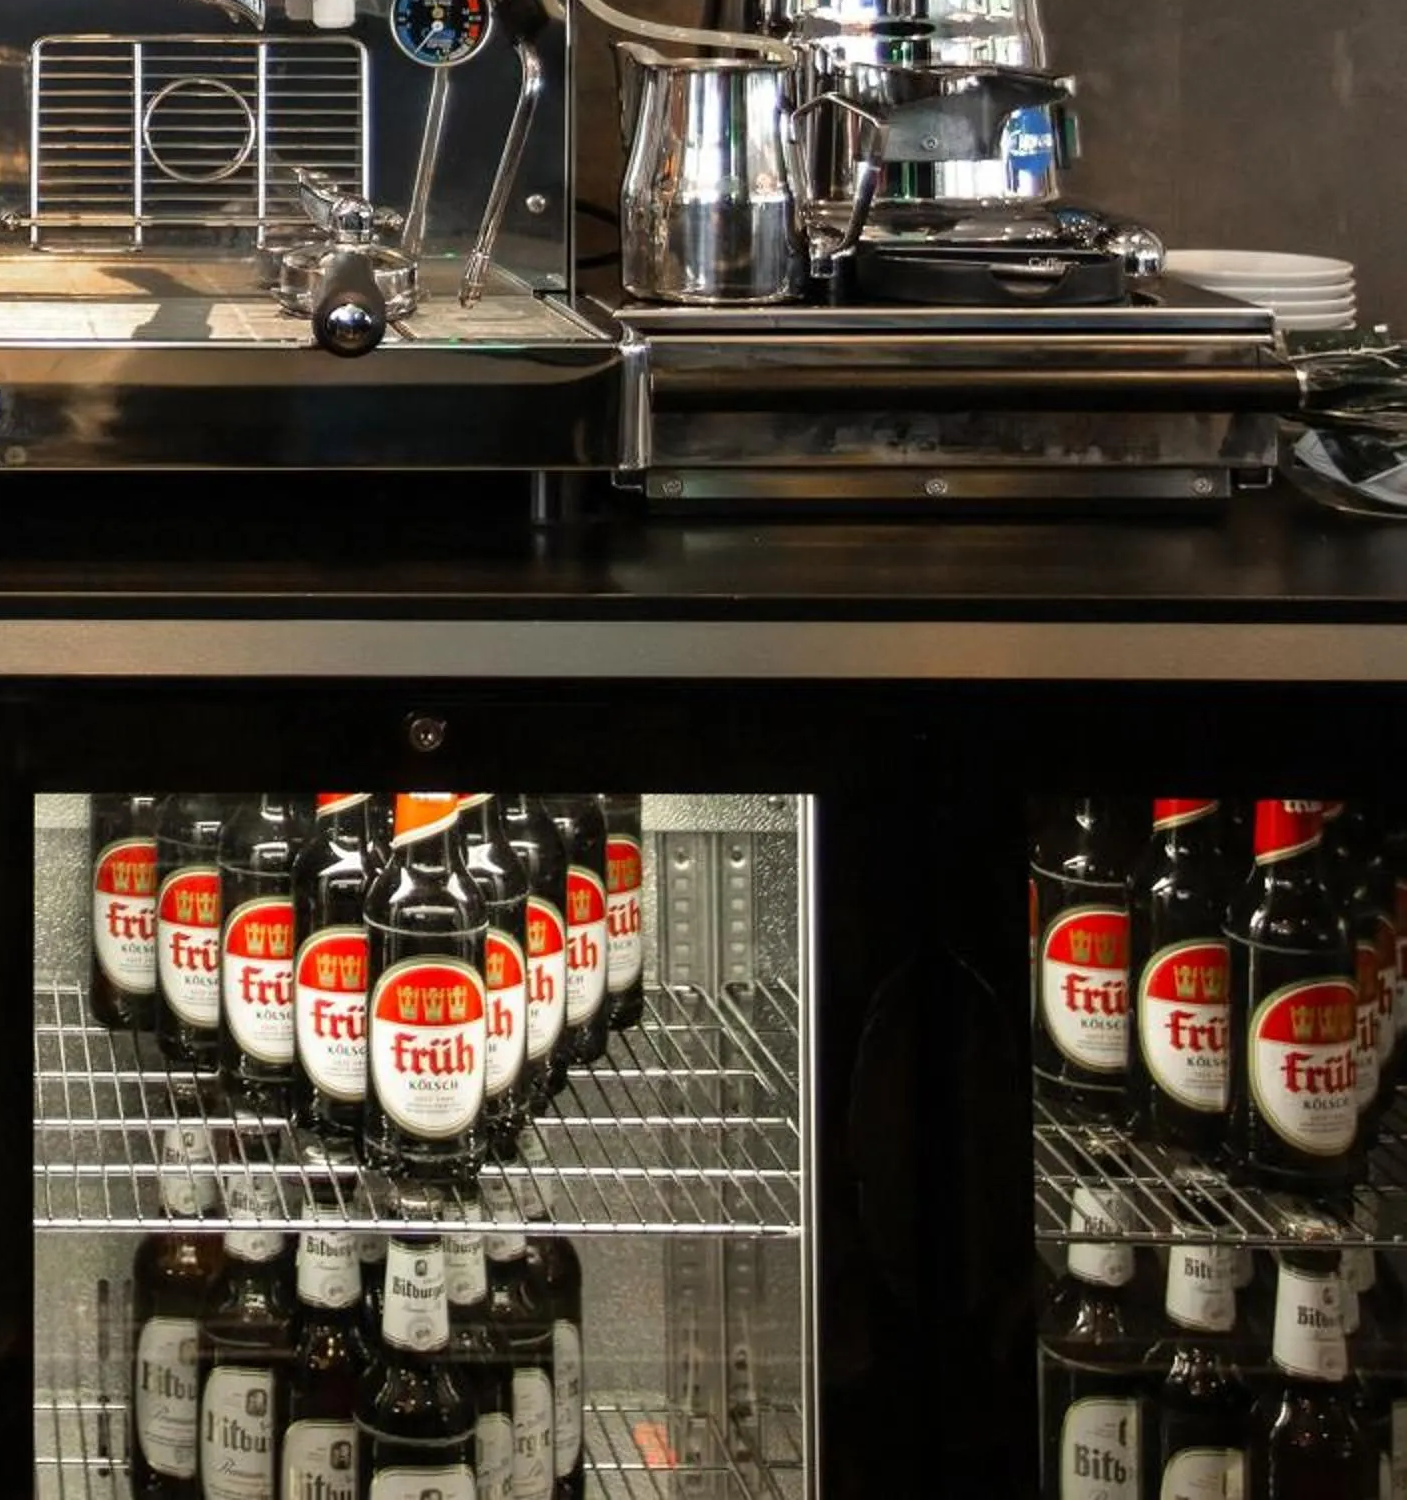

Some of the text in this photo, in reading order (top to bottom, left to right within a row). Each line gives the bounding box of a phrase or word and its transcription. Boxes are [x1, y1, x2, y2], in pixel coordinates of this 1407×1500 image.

[106, 901, 157, 941] frü
[609, 898, 641, 937] üh
[169, 931, 219, 973] frü
[238, 965, 293, 1006] frü
[1061, 972, 1126, 1017] frü
[310, 998, 367, 1041] frü
[1081, 1017, 1123, 1030] KÖLSC
[1165, 1010, 1228, 1053] frü
[390, 1032, 475, 1077] früh
[409, 1078, 459, 1091] KÖLSCH
